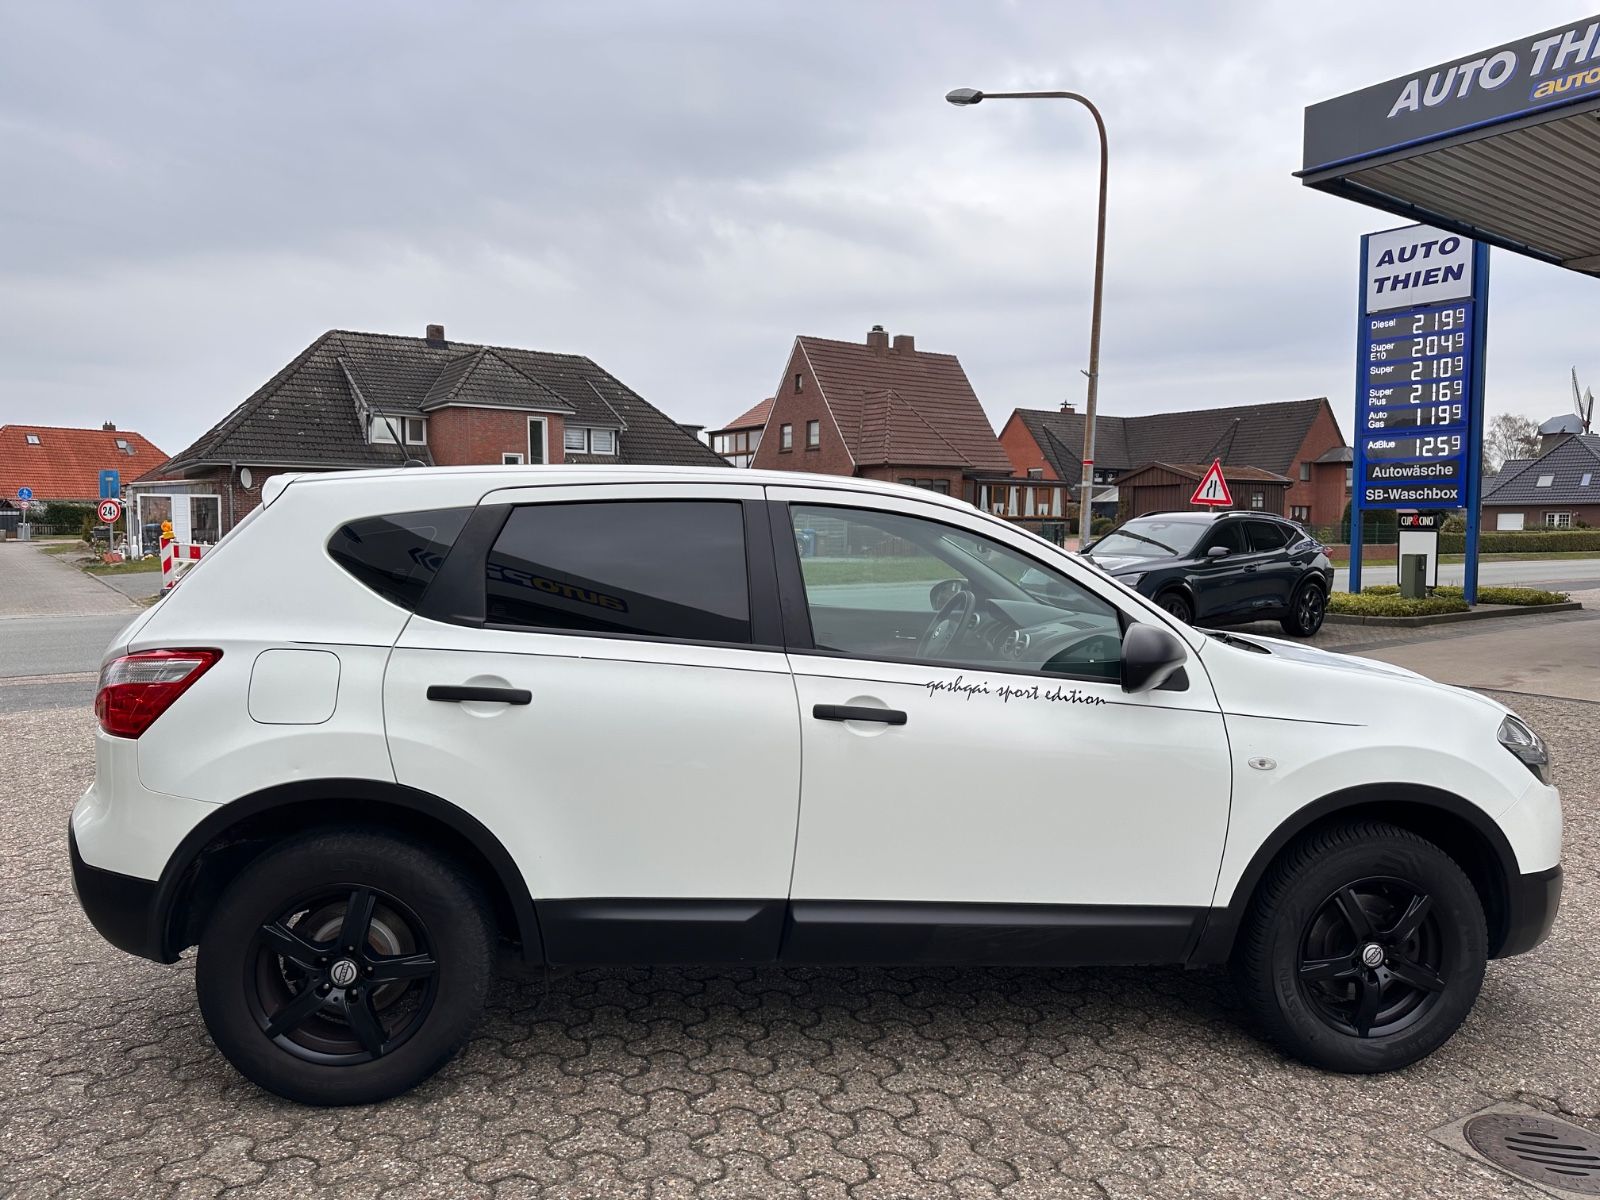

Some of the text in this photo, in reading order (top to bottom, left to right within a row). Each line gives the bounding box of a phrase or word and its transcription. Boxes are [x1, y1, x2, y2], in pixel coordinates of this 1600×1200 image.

[1387, 51, 1517, 118] AUTO
[1376, 237, 1461, 268] AUTO
[1373, 263, 1464, 294] THIEN
[1371, 318, 1396, 329] Diesel
[1370, 342, 1395, 353] Super
[1370, 352, 1387, 361] E10
[1369, 366, 1394, 376] Super
[1369, 387, 1394, 398] Super
[1368, 397, 1387, 406] Plus
[1368, 411, 1388, 420] Auto
[1367, 420, 1385, 429] Gas
[1367, 440, 1396, 449] AdBlue
[1372, 464, 1454, 478] Autowäsche
[1365, 488, 1458, 500] SB-Waschbox
[996, 685, 1039, 703] sport
[1045, 686, 1106, 704] edition
